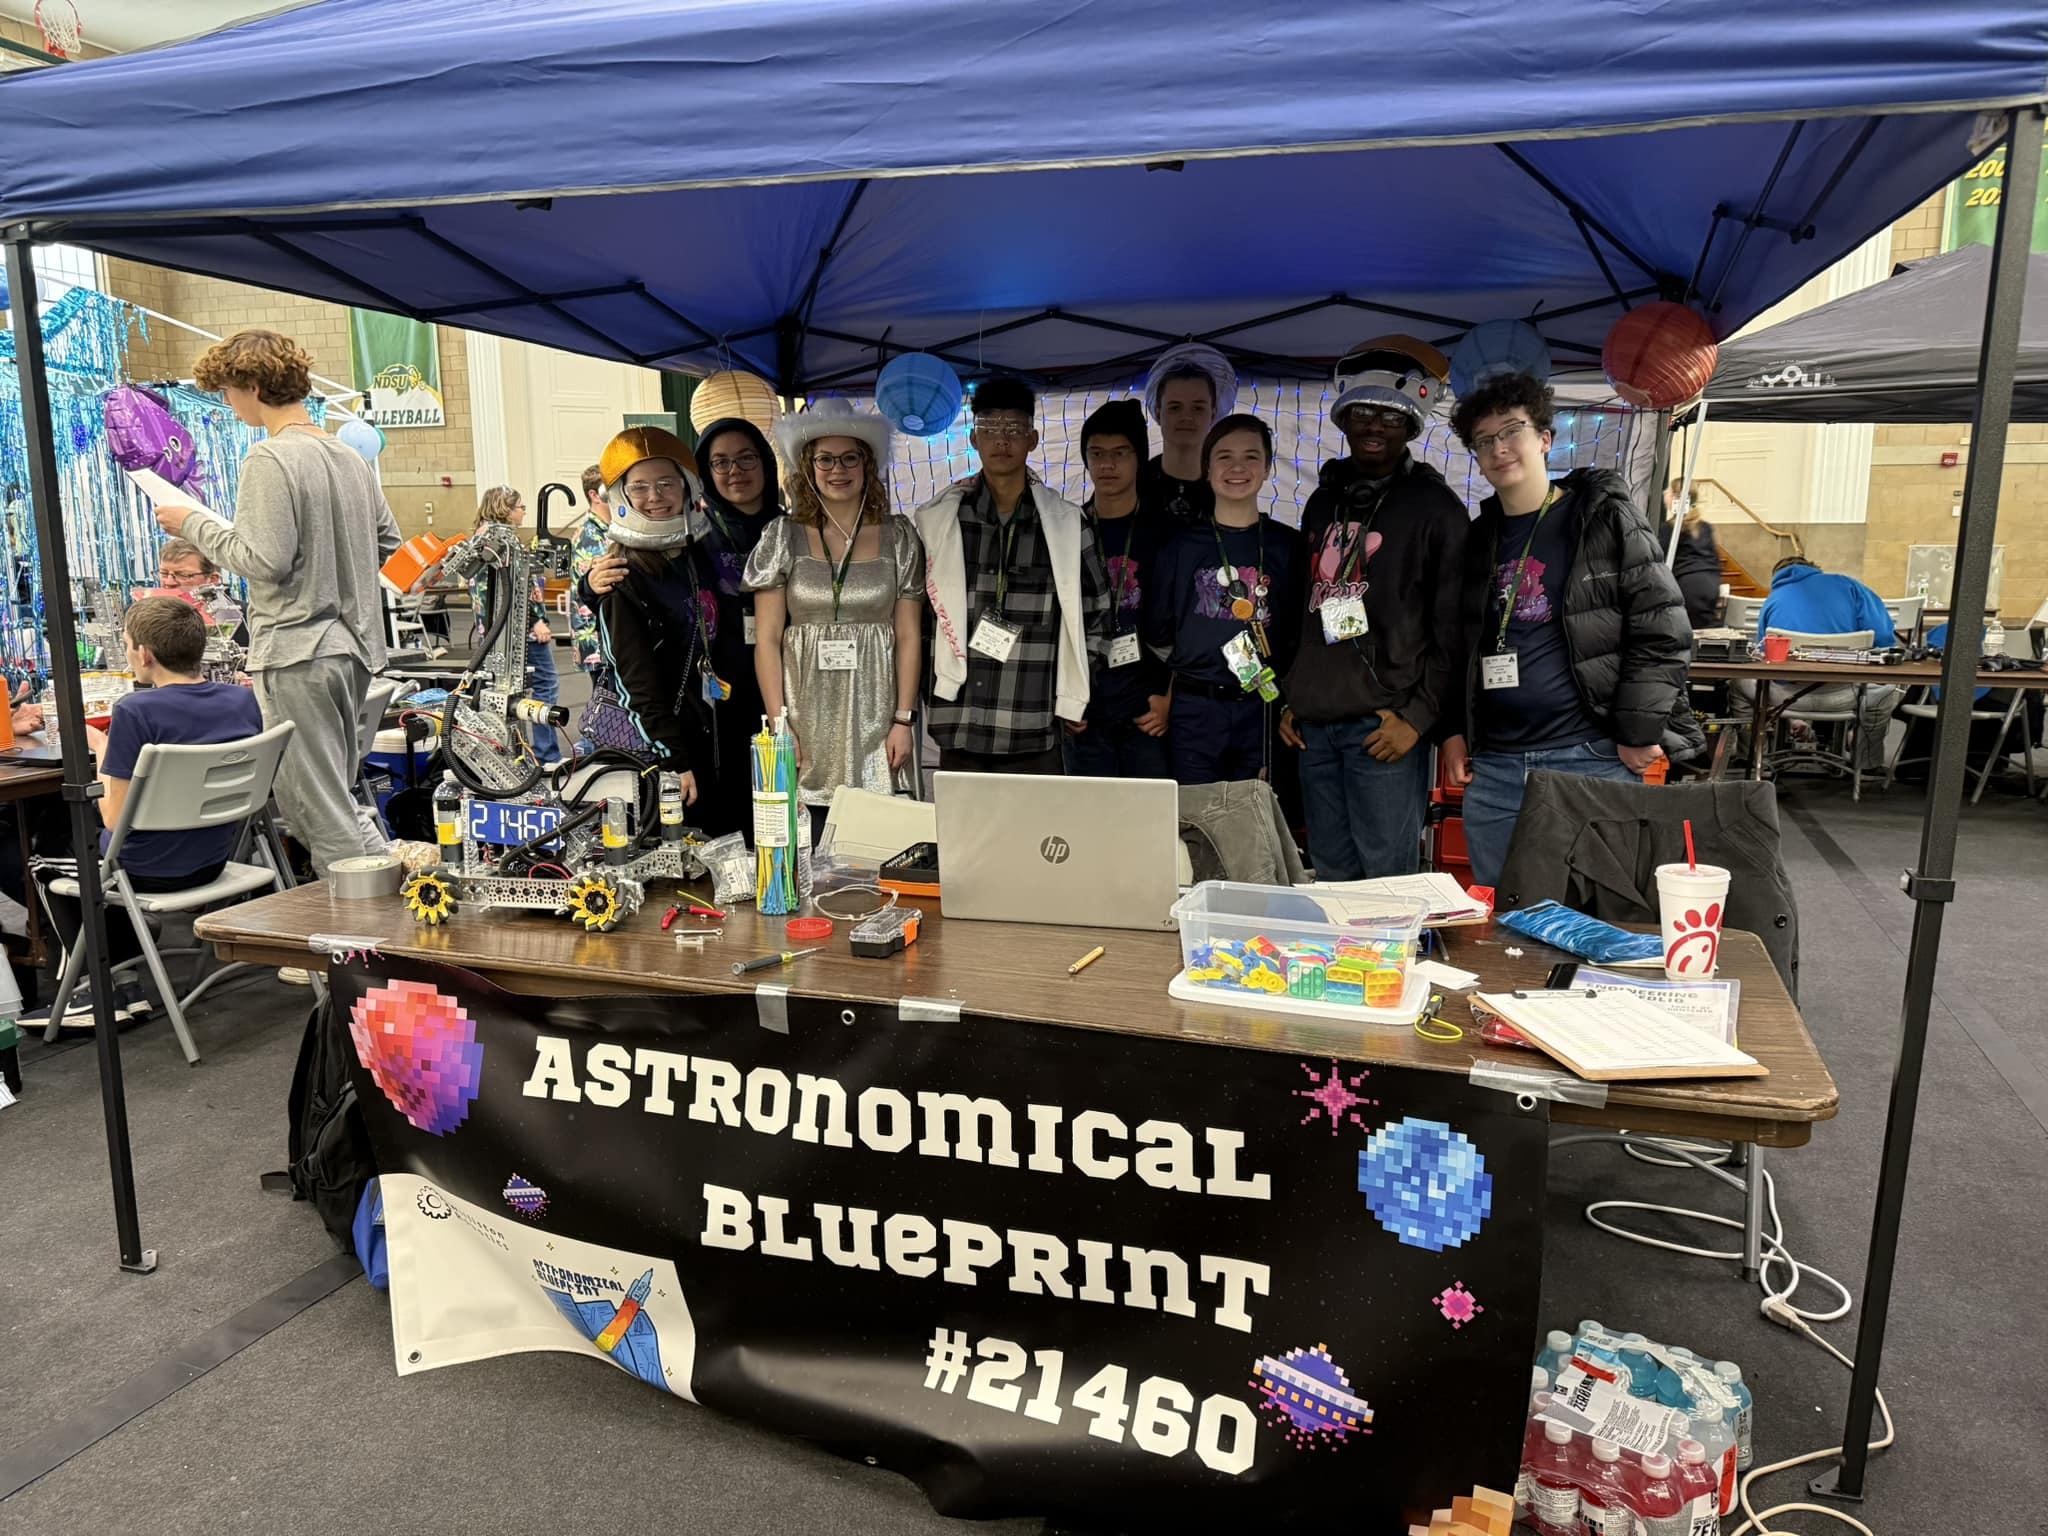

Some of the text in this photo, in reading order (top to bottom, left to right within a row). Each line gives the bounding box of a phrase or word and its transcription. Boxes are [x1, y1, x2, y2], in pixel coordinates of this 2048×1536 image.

[373, 375, 408, 389] NDSU
[1762, 365, 1821, 388] YOLI
[357, 408, 440, 425] VLLEYBALL
[471, 803, 558, 847] 21460
[1044, 835, 1067, 864] hp
[923, 1327, 1258, 1475] #21460
